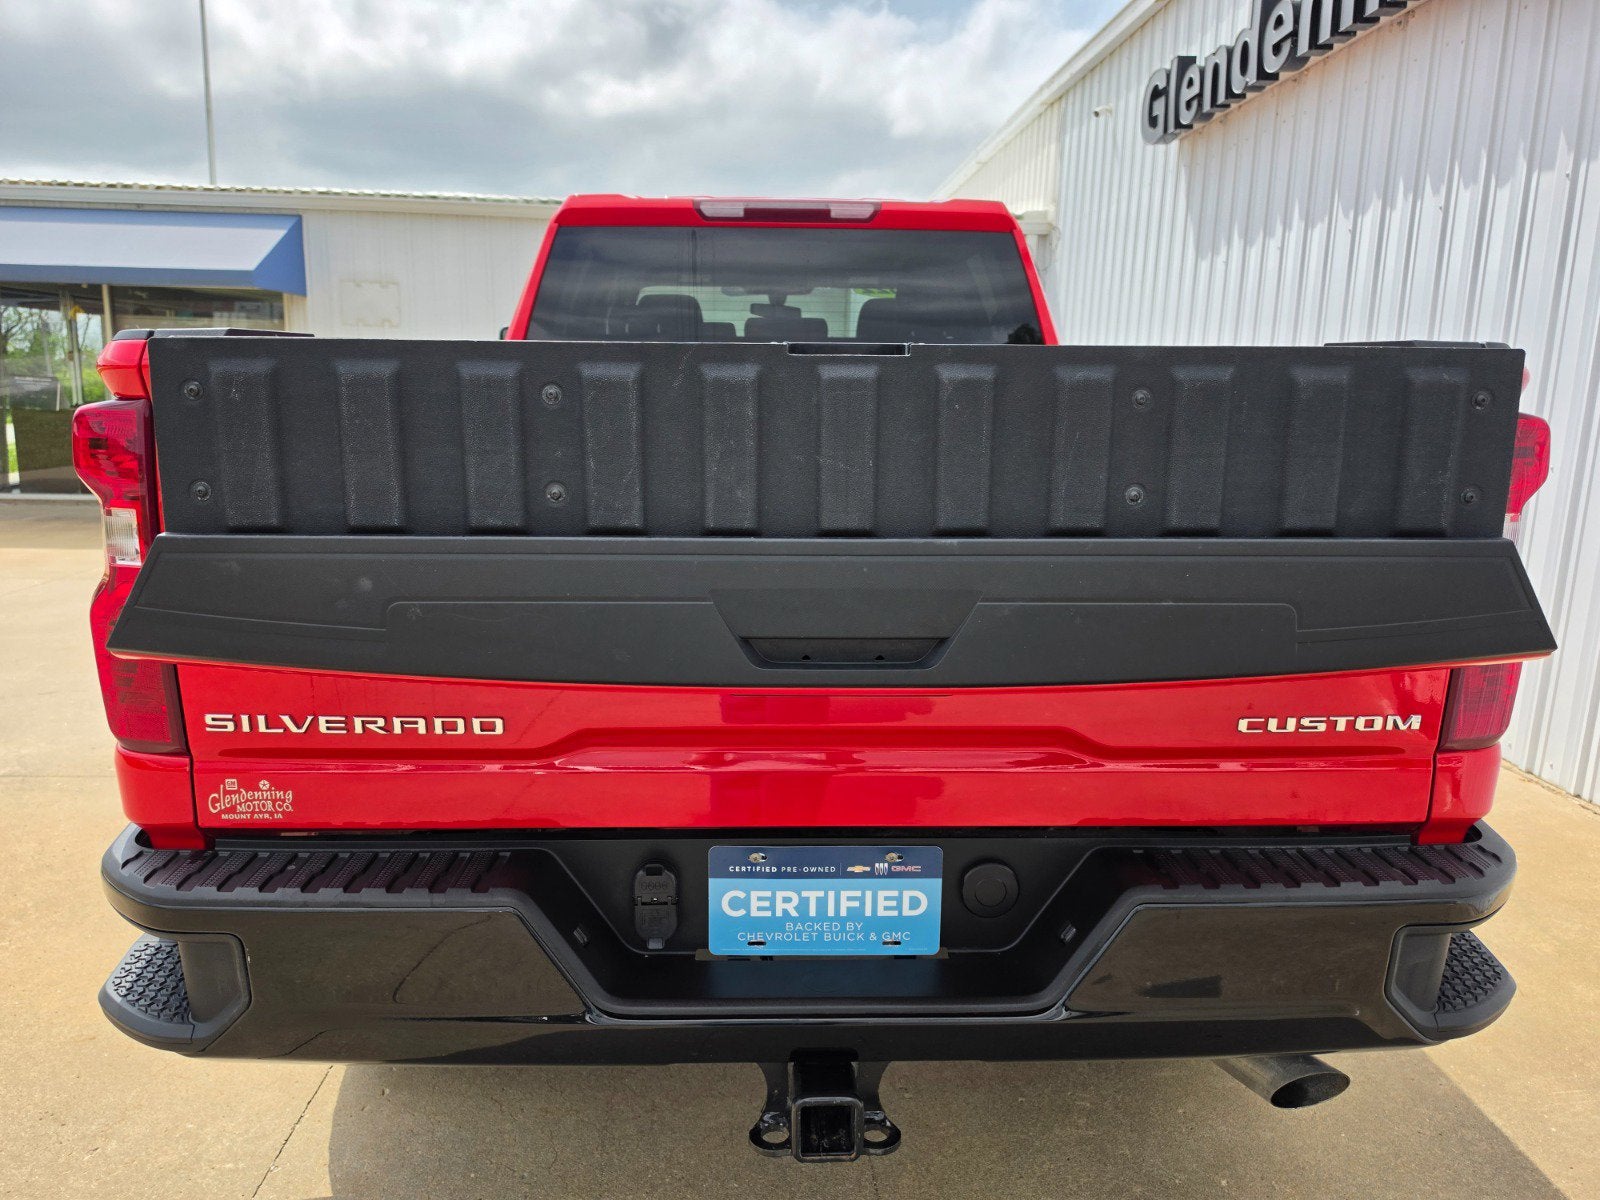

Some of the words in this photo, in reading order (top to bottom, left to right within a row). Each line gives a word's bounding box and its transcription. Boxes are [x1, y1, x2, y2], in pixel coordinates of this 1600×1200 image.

[204, 713, 505, 735] SILVERADO
[1237, 714, 1422, 733] CUSTOM
[208, 784, 293, 813] Glendenning
[236, 800, 275, 812] MOTOR
[276, 801, 294, 811] CO.
[729, 865, 777, 873] CERTIFIED
[721, 889, 929, 917] CERTIFIED
[786, 922, 841, 931] BACKED
[846, 922, 864, 931] BY
[737, 932, 817, 942] CHEVROLET
[824, 932, 865, 941] BUICK
[869, 932, 878, 941] &
[882, 931, 911, 941] GMC
